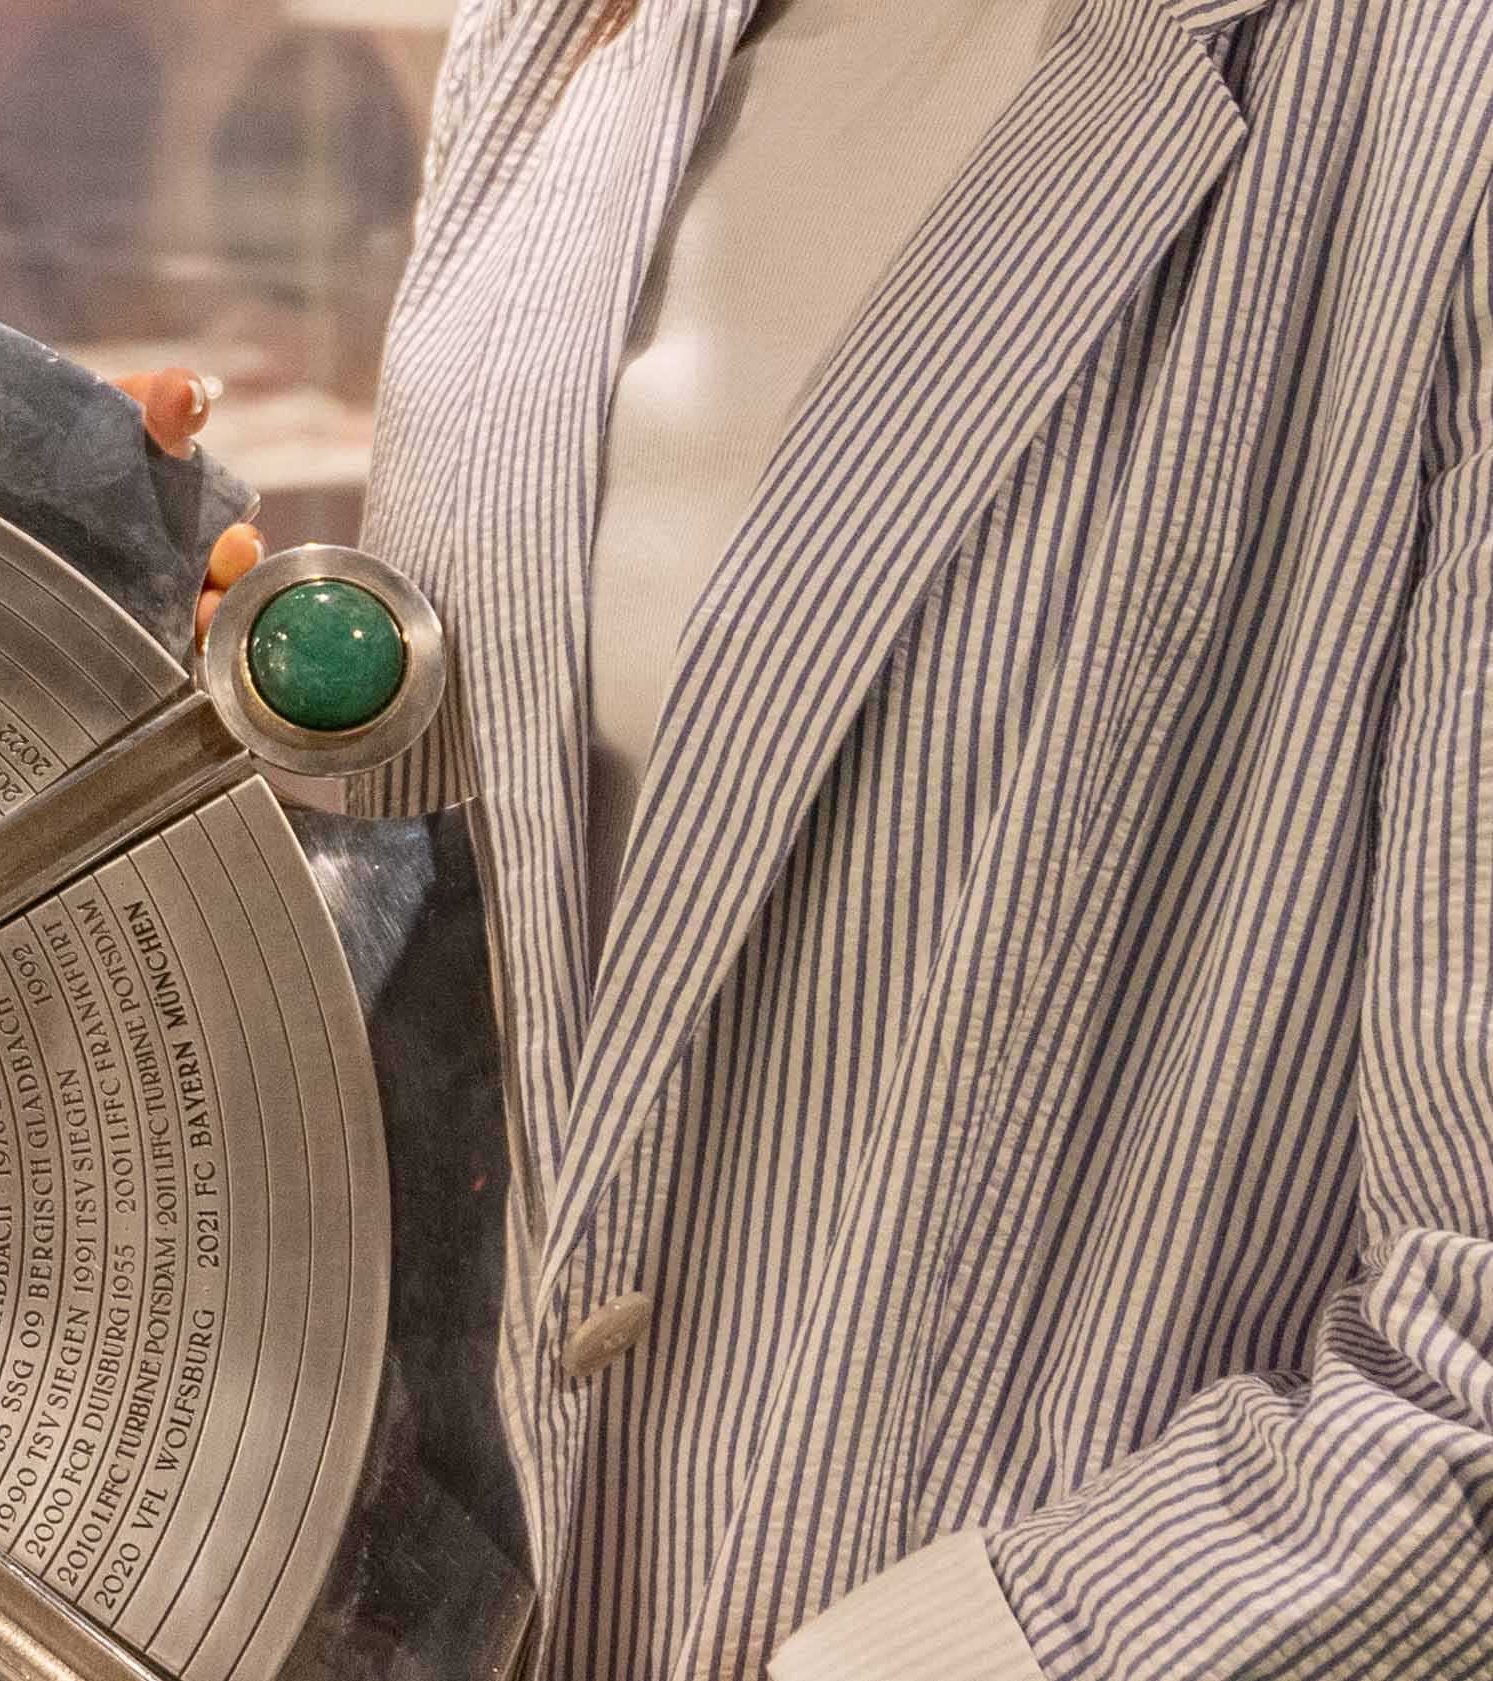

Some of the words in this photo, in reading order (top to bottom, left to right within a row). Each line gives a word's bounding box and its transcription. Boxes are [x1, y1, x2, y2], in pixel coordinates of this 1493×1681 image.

[11, 943, 54, 1006] 1992
[76, 898, 141, 1014] POTSDAM
[123, 900, 188, 1031] MÜNCHEN
[42, 920, 116, 1073] FRANKFURT
[124, 1015, 167, 1116] TURBINE
[171, 1041, 213, 1149] BAYERN
[55, 1069, 94, 1172] SIEGEN
[73, 1178, 97, 1228] TSV
[111, 1148, 137, 1212] 2001
[154, 1175, 178, 1226] 2011
[193, 1161, 217, 1197] FC
[73, 1237, 97, 1293] 1991
[111, 1244, 135, 1300] 1955
[196, 1210, 220, 1268] 2021
[0, 1359, 35, 1413] SSG
[27, 1158, 55, 1299] BERGISCH
[143, 1237, 176, 1356] POTSDAM
[46, 1305, 90, 1410] SIEGEN
[81, 1307, 130, 1433] DUISBURG
[154, 1309, 215, 1471] WOLFSBURG
[26, 1410, 61, 1461] TSV
[114, 1359, 162, 1460] TURBINE
[60, 1438, 96, 1486] FCR
[24, 1487, 73, 1559] 2000
[130, 1488, 168, 1529] VFL
[57, 1523, 103, 1587] 2010
[93, 1542, 141, 1610] 2020
